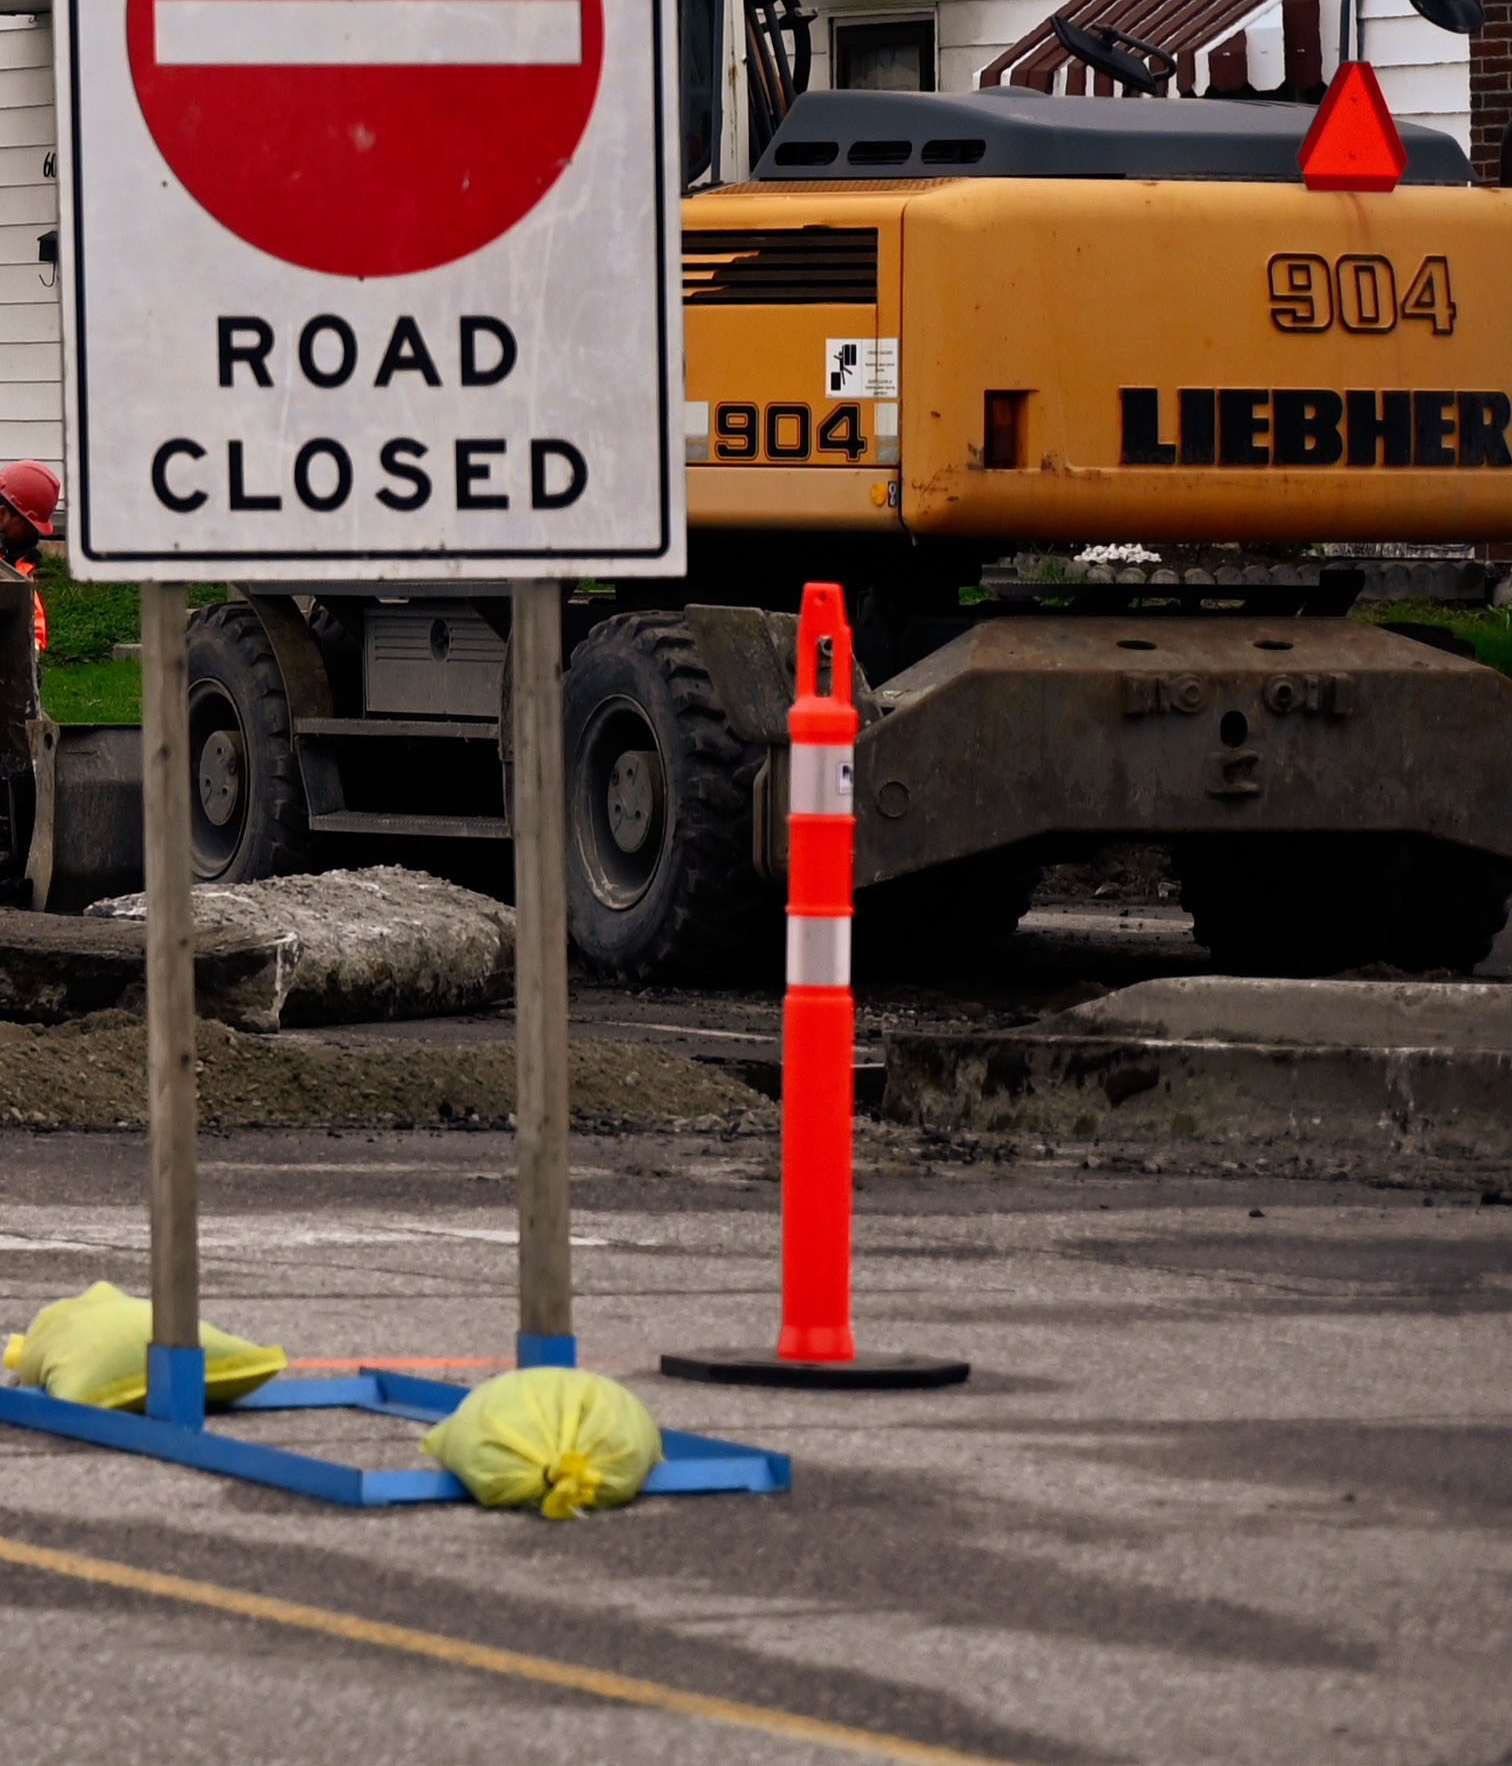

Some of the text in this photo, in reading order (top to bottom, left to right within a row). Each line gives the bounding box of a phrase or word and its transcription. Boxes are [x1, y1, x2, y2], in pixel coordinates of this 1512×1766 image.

[1267, 253, 1457, 335] 904
[217, 313, 518, 388] ROAD
[714, 402, 867, 462] 904
[1120, 388, 1512, 467] LIEBHER
[151, 437, 588, 513] CLOSED
